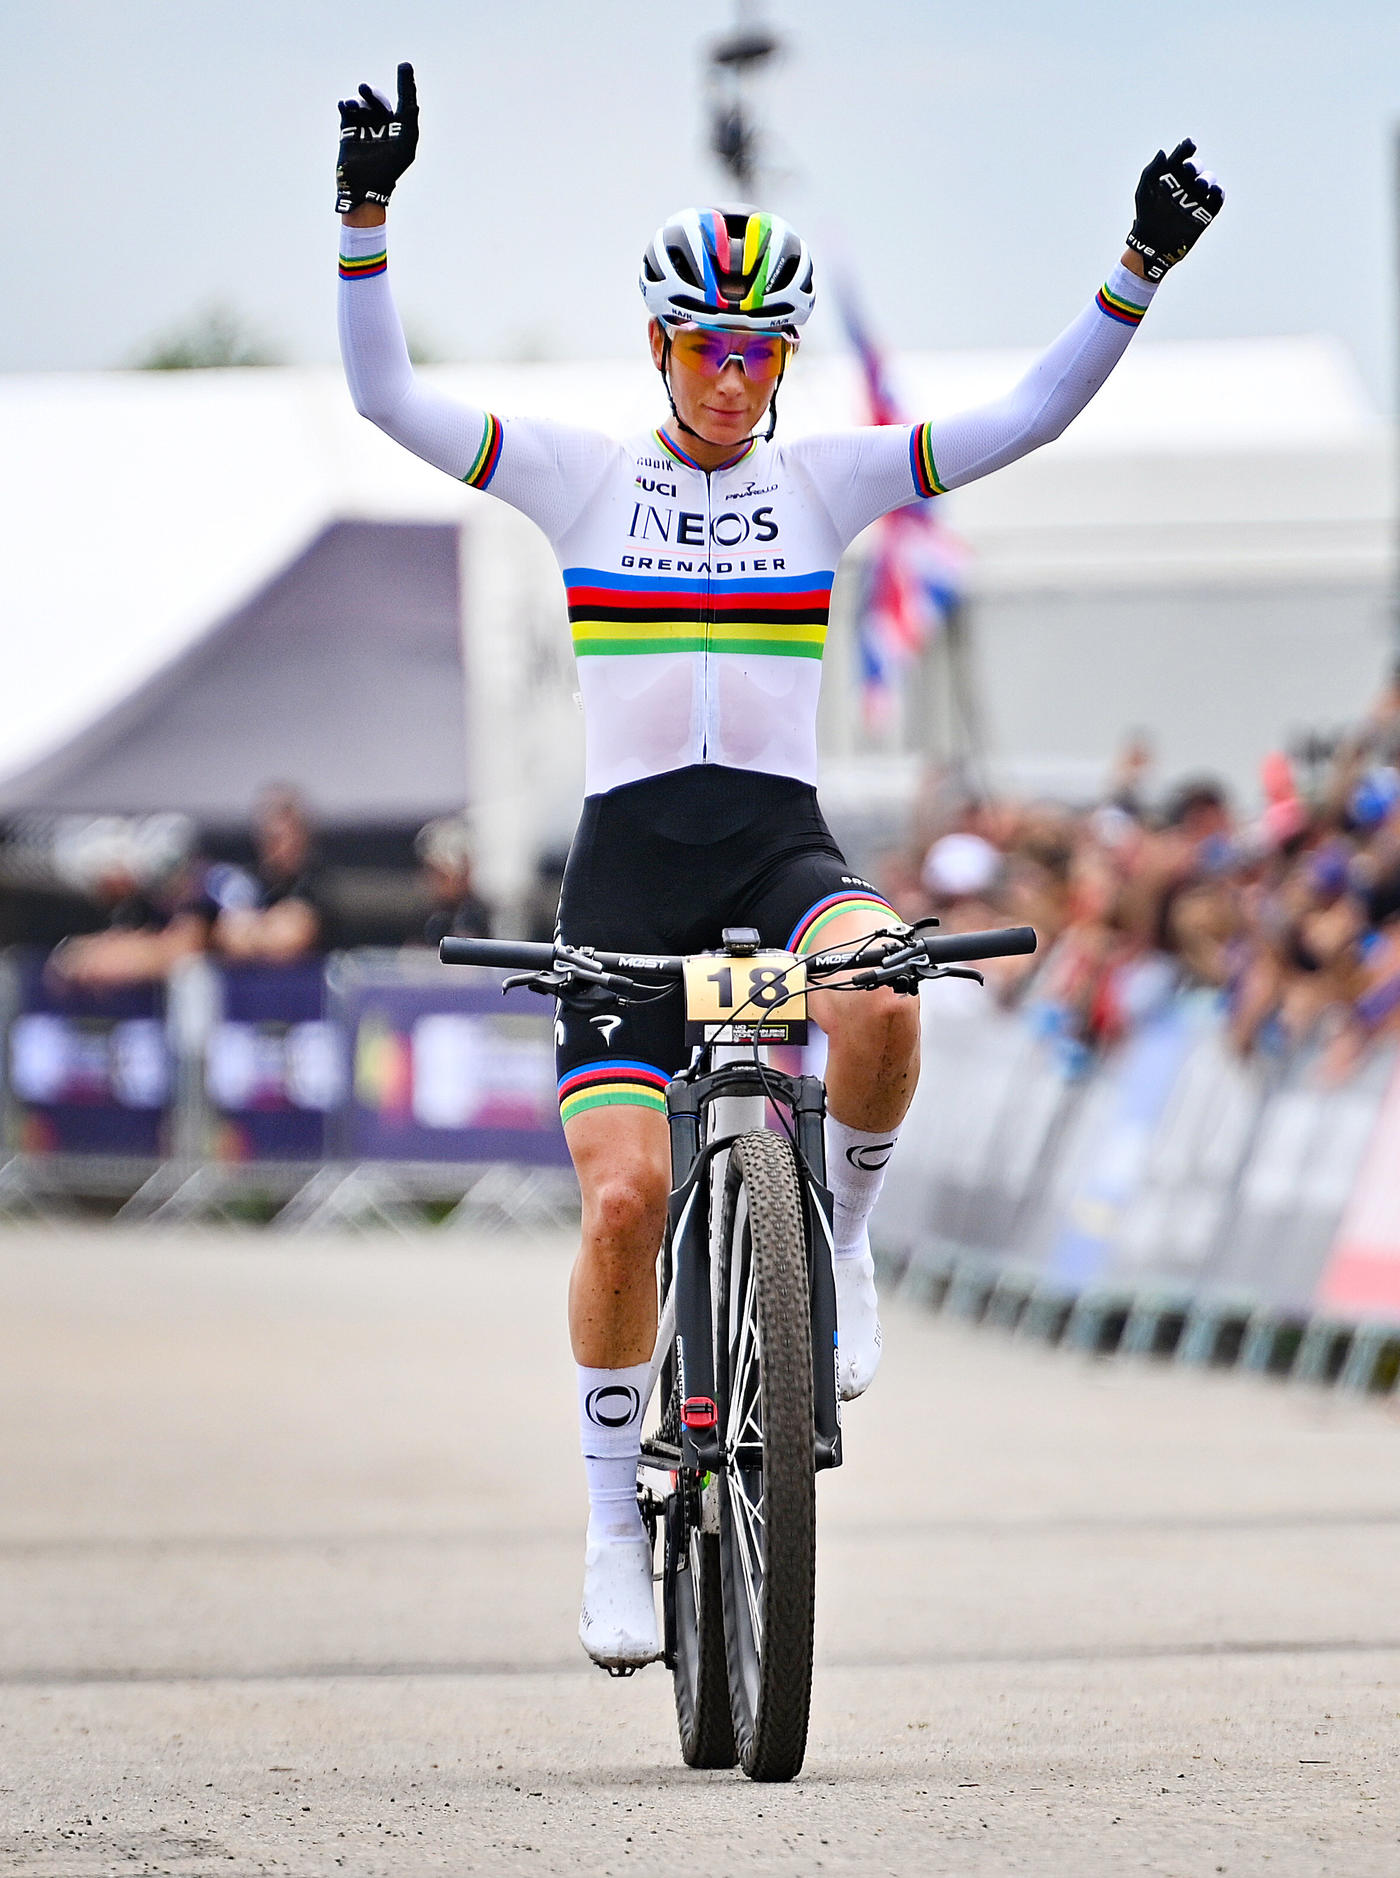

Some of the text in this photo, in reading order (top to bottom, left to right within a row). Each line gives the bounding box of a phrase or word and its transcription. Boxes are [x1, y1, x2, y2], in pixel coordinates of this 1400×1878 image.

[341, 121, 402, 140] FIVE
[1159, 173, 1213, 225] FIVE
[1128, 234, 1156, 257] FIVE
[642, 478, 677, 498] UCI
[627, 502, 779, 546] INEOS
[621, 555, 787, 574] GRENADIER
[707, 967, 789, 1009] 18
